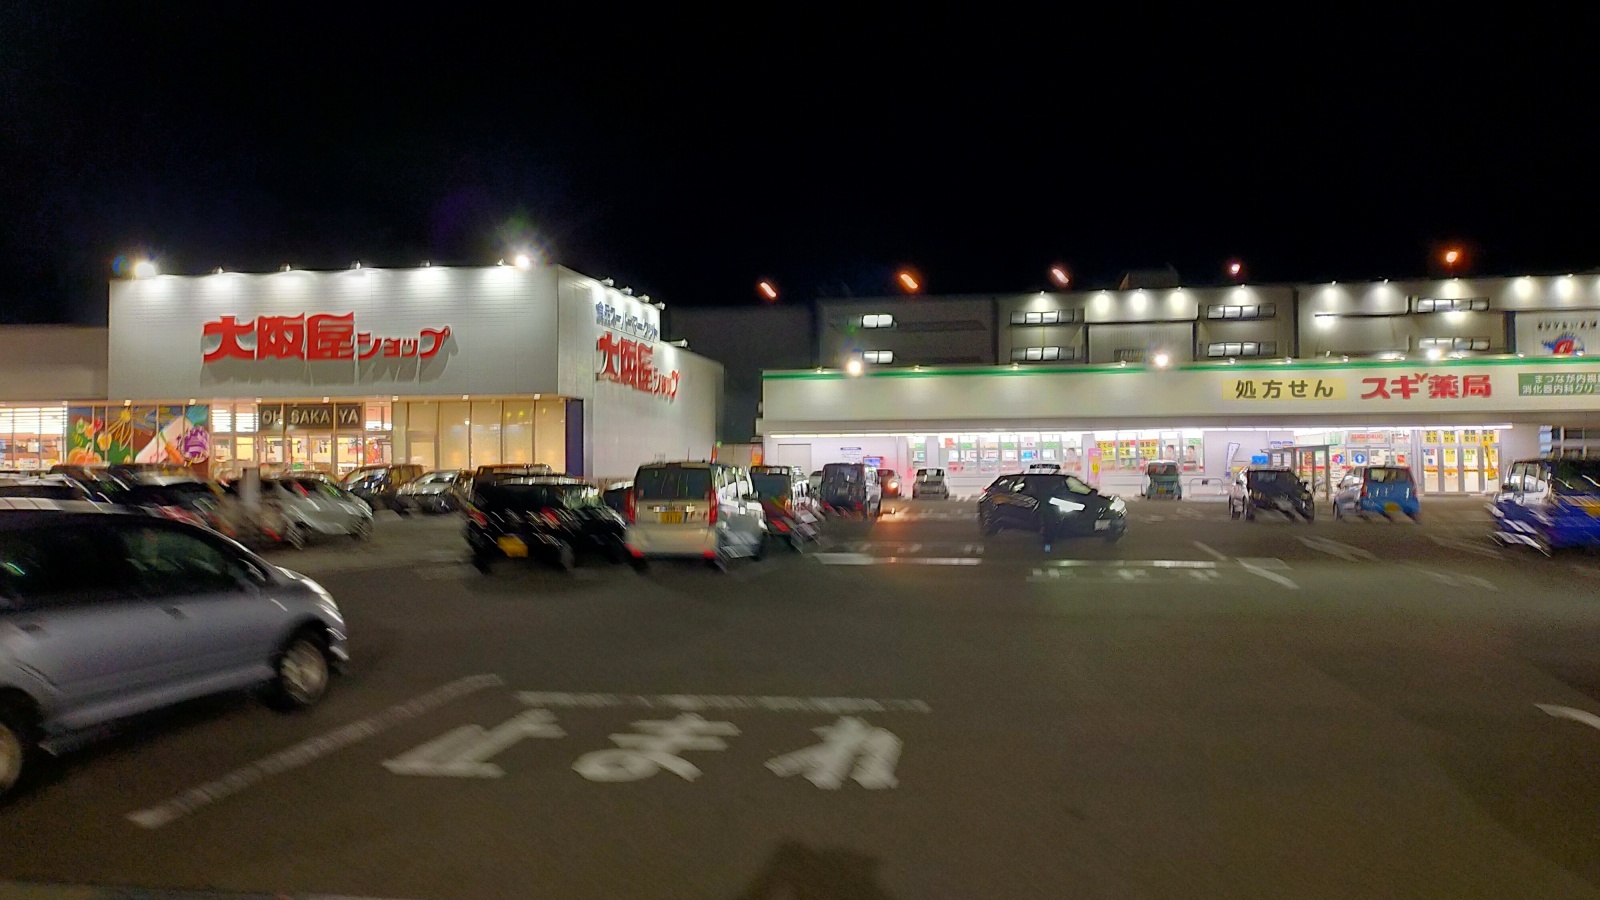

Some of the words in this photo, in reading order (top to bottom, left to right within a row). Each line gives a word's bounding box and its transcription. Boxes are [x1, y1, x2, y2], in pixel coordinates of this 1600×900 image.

[203, 311, 451, 363] 大阪屋ショップ
[597, 331, 680, 398] 大阪屋ショップ
[1235, 379, 1334, 399] 処方せん
[1361, 373, 1492, 399] スギ薬局
[290, 409, 331, 424] SAKA
[338, 409, 359, 424] YA
[381, 707, 905, 791] 止まれ
